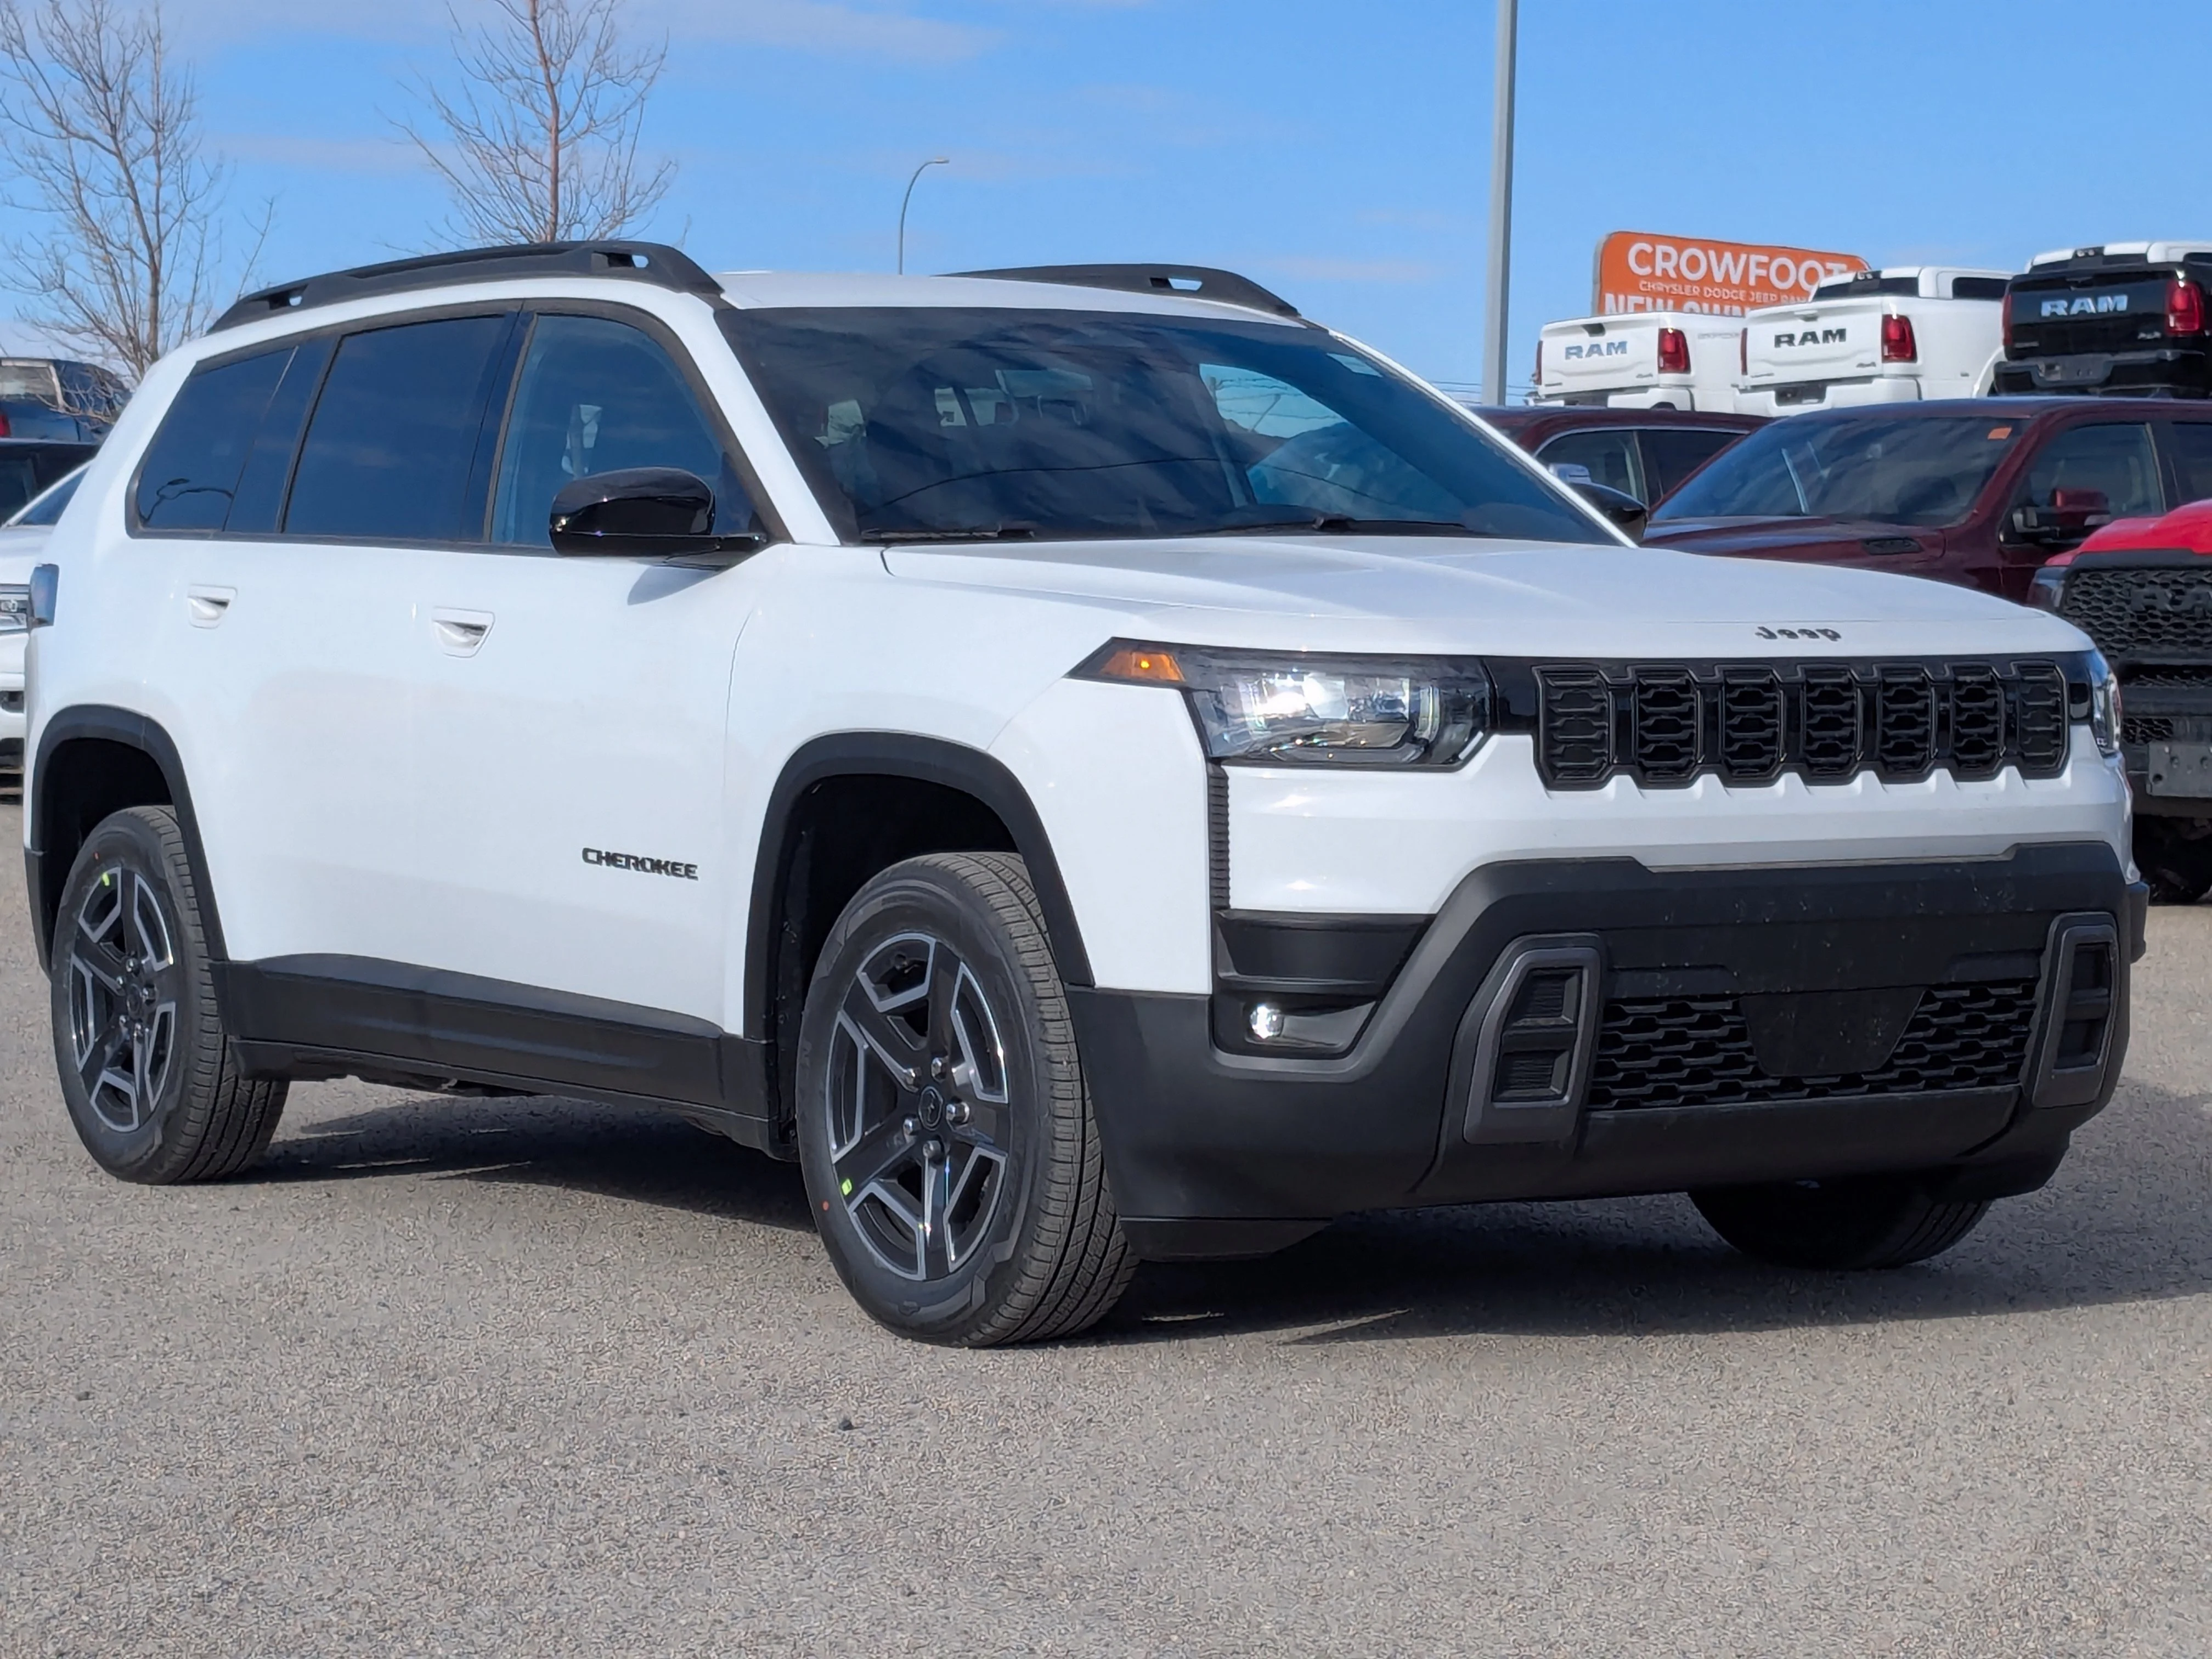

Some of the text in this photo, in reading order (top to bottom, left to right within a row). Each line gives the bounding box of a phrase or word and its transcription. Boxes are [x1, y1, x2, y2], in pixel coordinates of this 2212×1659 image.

[1639, 280, 1700, 297] CHRYSLER
[1703, 286, 1747, 301] DODGE
[1748, 290, 1779, 303] JEEP
[2040, 294, 2129, 317] RAM
[1774, 328, 1847, 348] RAM
[1565, 340, 1628, 360] RAM
[1754, 626, 1842, 642] Jeep
[582, 847, 699, 881] CHEROKEE
